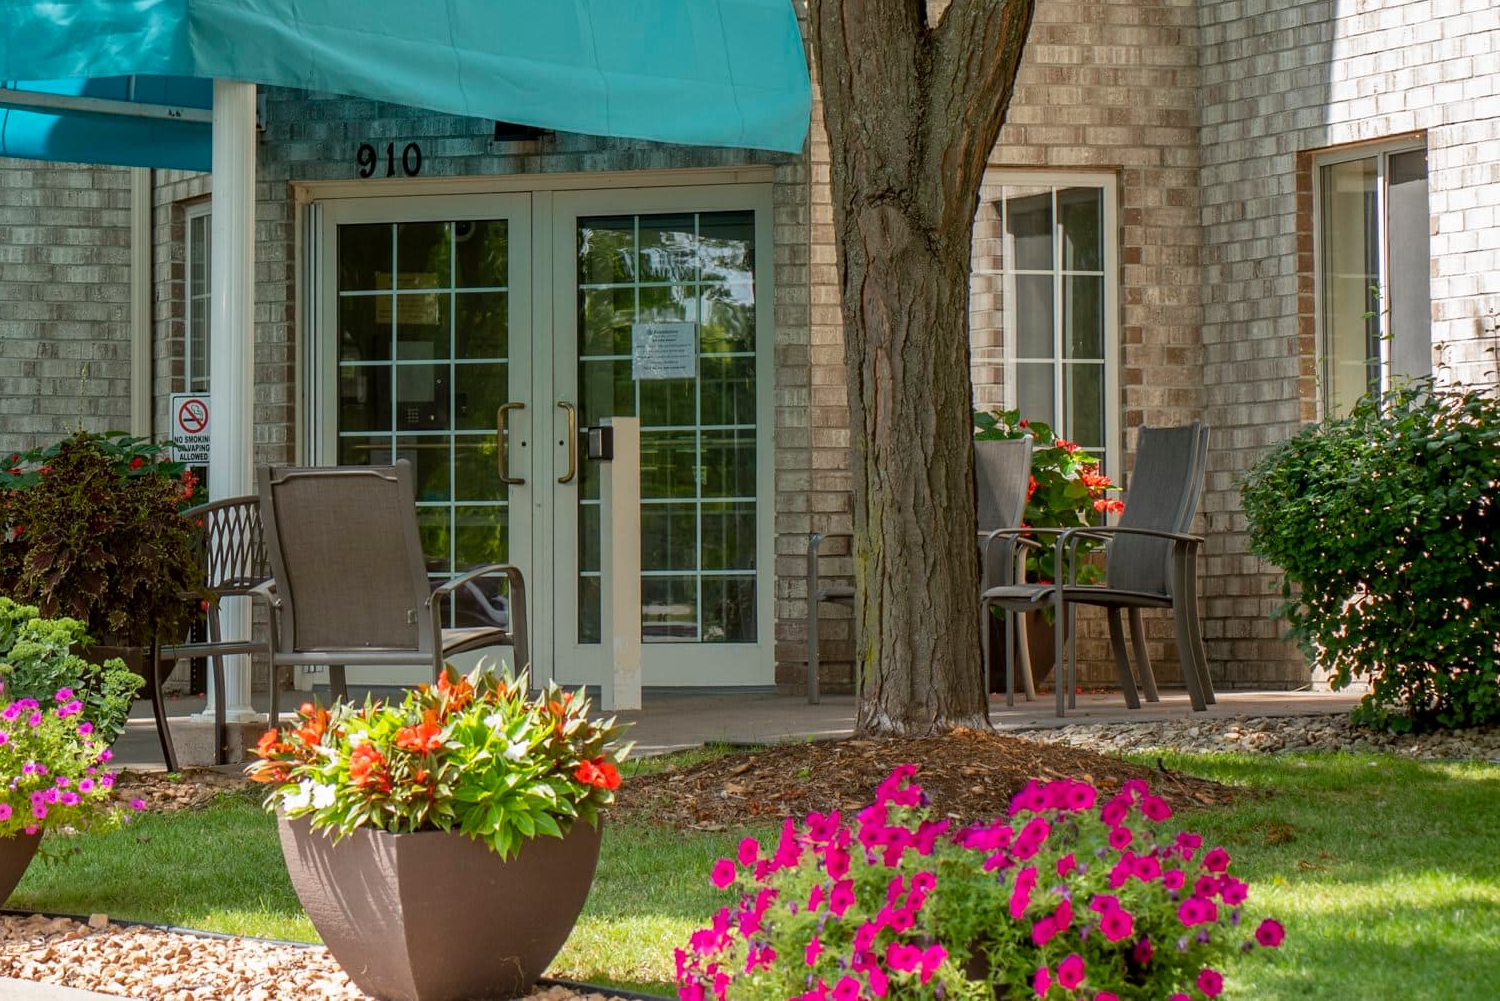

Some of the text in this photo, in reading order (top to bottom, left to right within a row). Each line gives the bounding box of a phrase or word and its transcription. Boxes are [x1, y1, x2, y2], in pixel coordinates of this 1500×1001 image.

[357, 142, 422, 178] 910
[174, 436, 211, 444] NO SMOKIN
[188, 444, 211, 452] VAPING
[179, 453, 209, 461] ALLOWED
